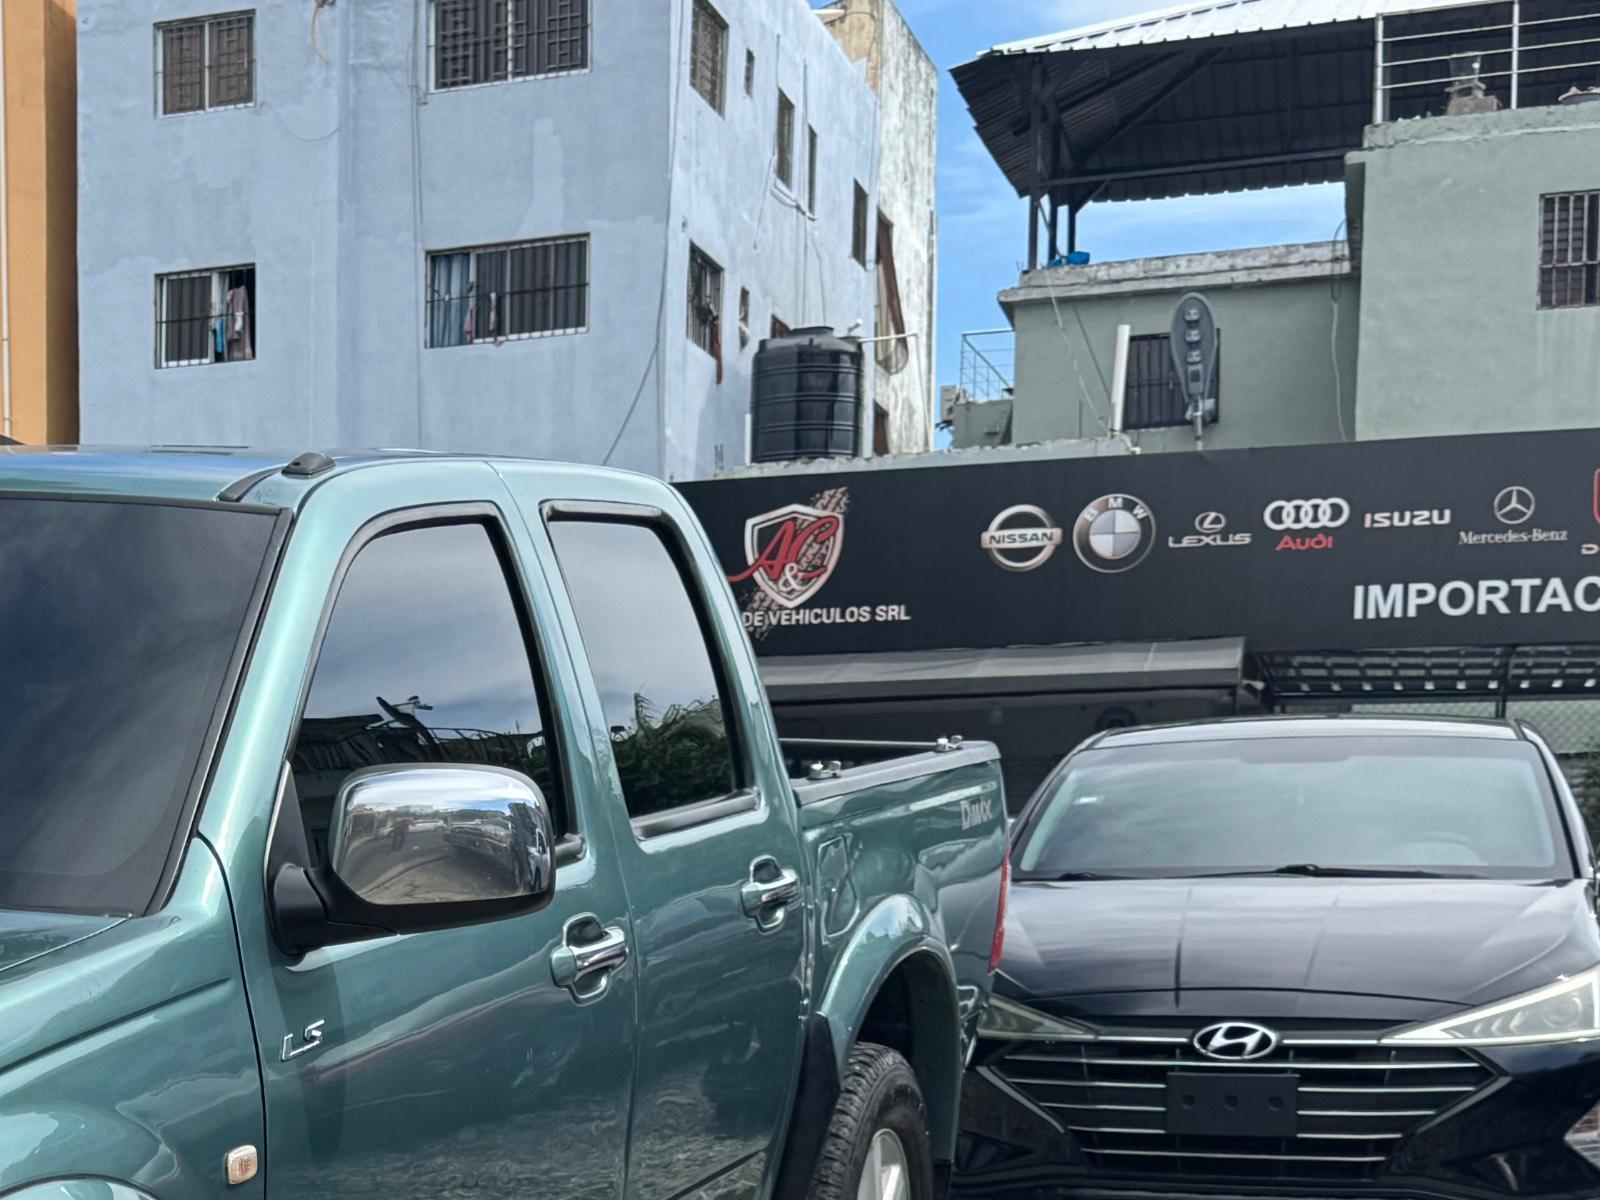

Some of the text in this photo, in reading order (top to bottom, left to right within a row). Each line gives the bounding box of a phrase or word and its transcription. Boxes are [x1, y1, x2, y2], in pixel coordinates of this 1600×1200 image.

[1083, 497, 1149, 522] BMW
[1364, 508, 1451, 528] ISUZU
[988, 531, 1054, 546] NISSAN
[1168, 533, 1252, 548] LEXUS
[1275, 533, 1333, 551] Audi
[1458, 528, 1568, 545] Mercedes-Benz
[1353, 575, 1600, 620] IMPORTAC
[768, 606, 871, 625] VEHICULOS
[875, 605, 911, 621] SRL
[282, 1019, 325, 1061] LS
